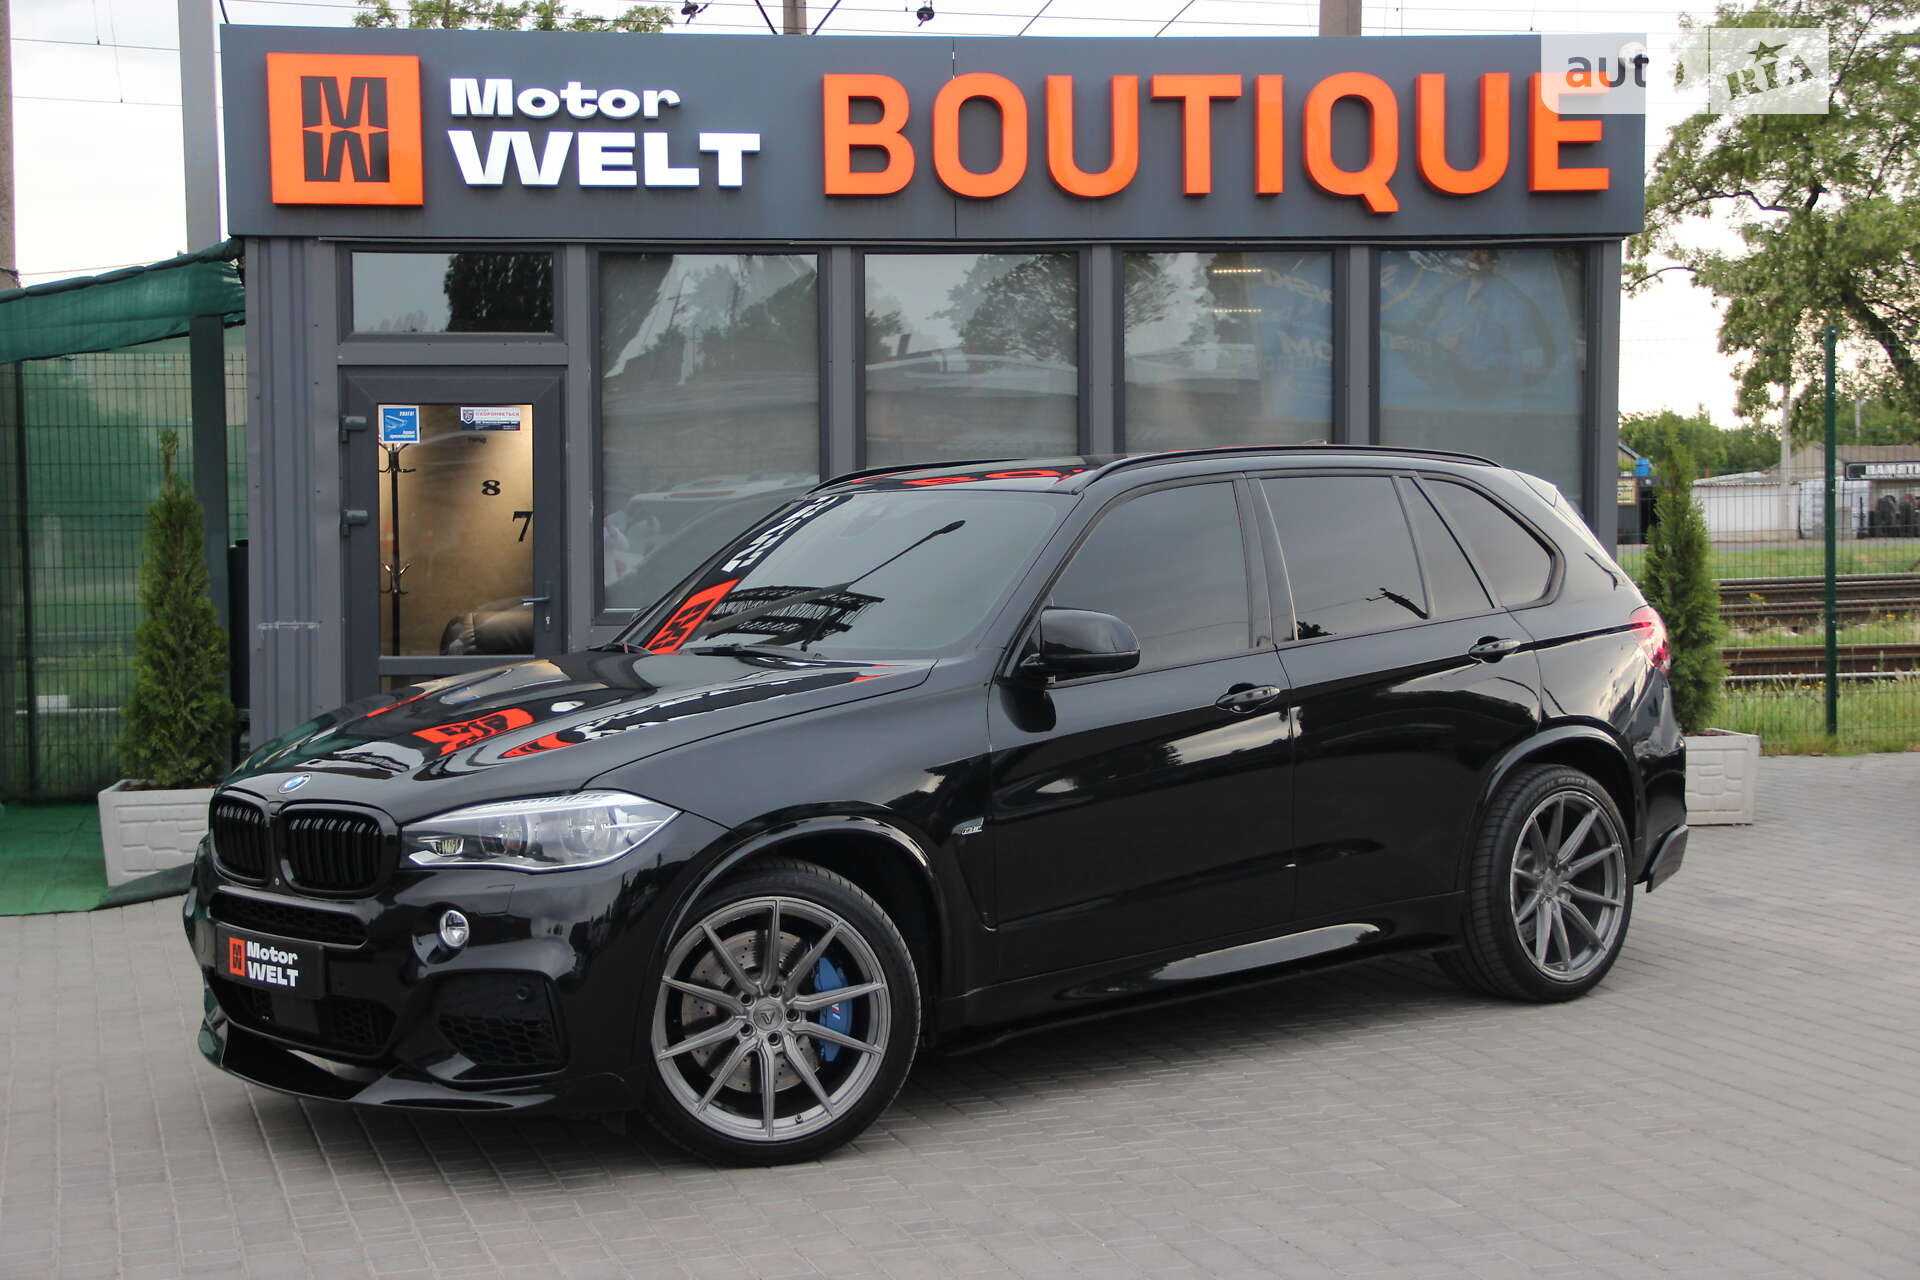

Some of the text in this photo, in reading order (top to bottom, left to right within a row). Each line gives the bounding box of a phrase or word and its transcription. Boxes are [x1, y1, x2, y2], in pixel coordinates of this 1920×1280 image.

[449, 77, 680, 119] Motor
[823, 71, 1610, 214] BOUTIQUE
[447, 130, 761, 188] WELT
[481, 479, 501, 496] 8
[512, 511, 534, 543] 7
[247, 941, 298, 965] Motor
[247, 961, 299, 987] WELT
